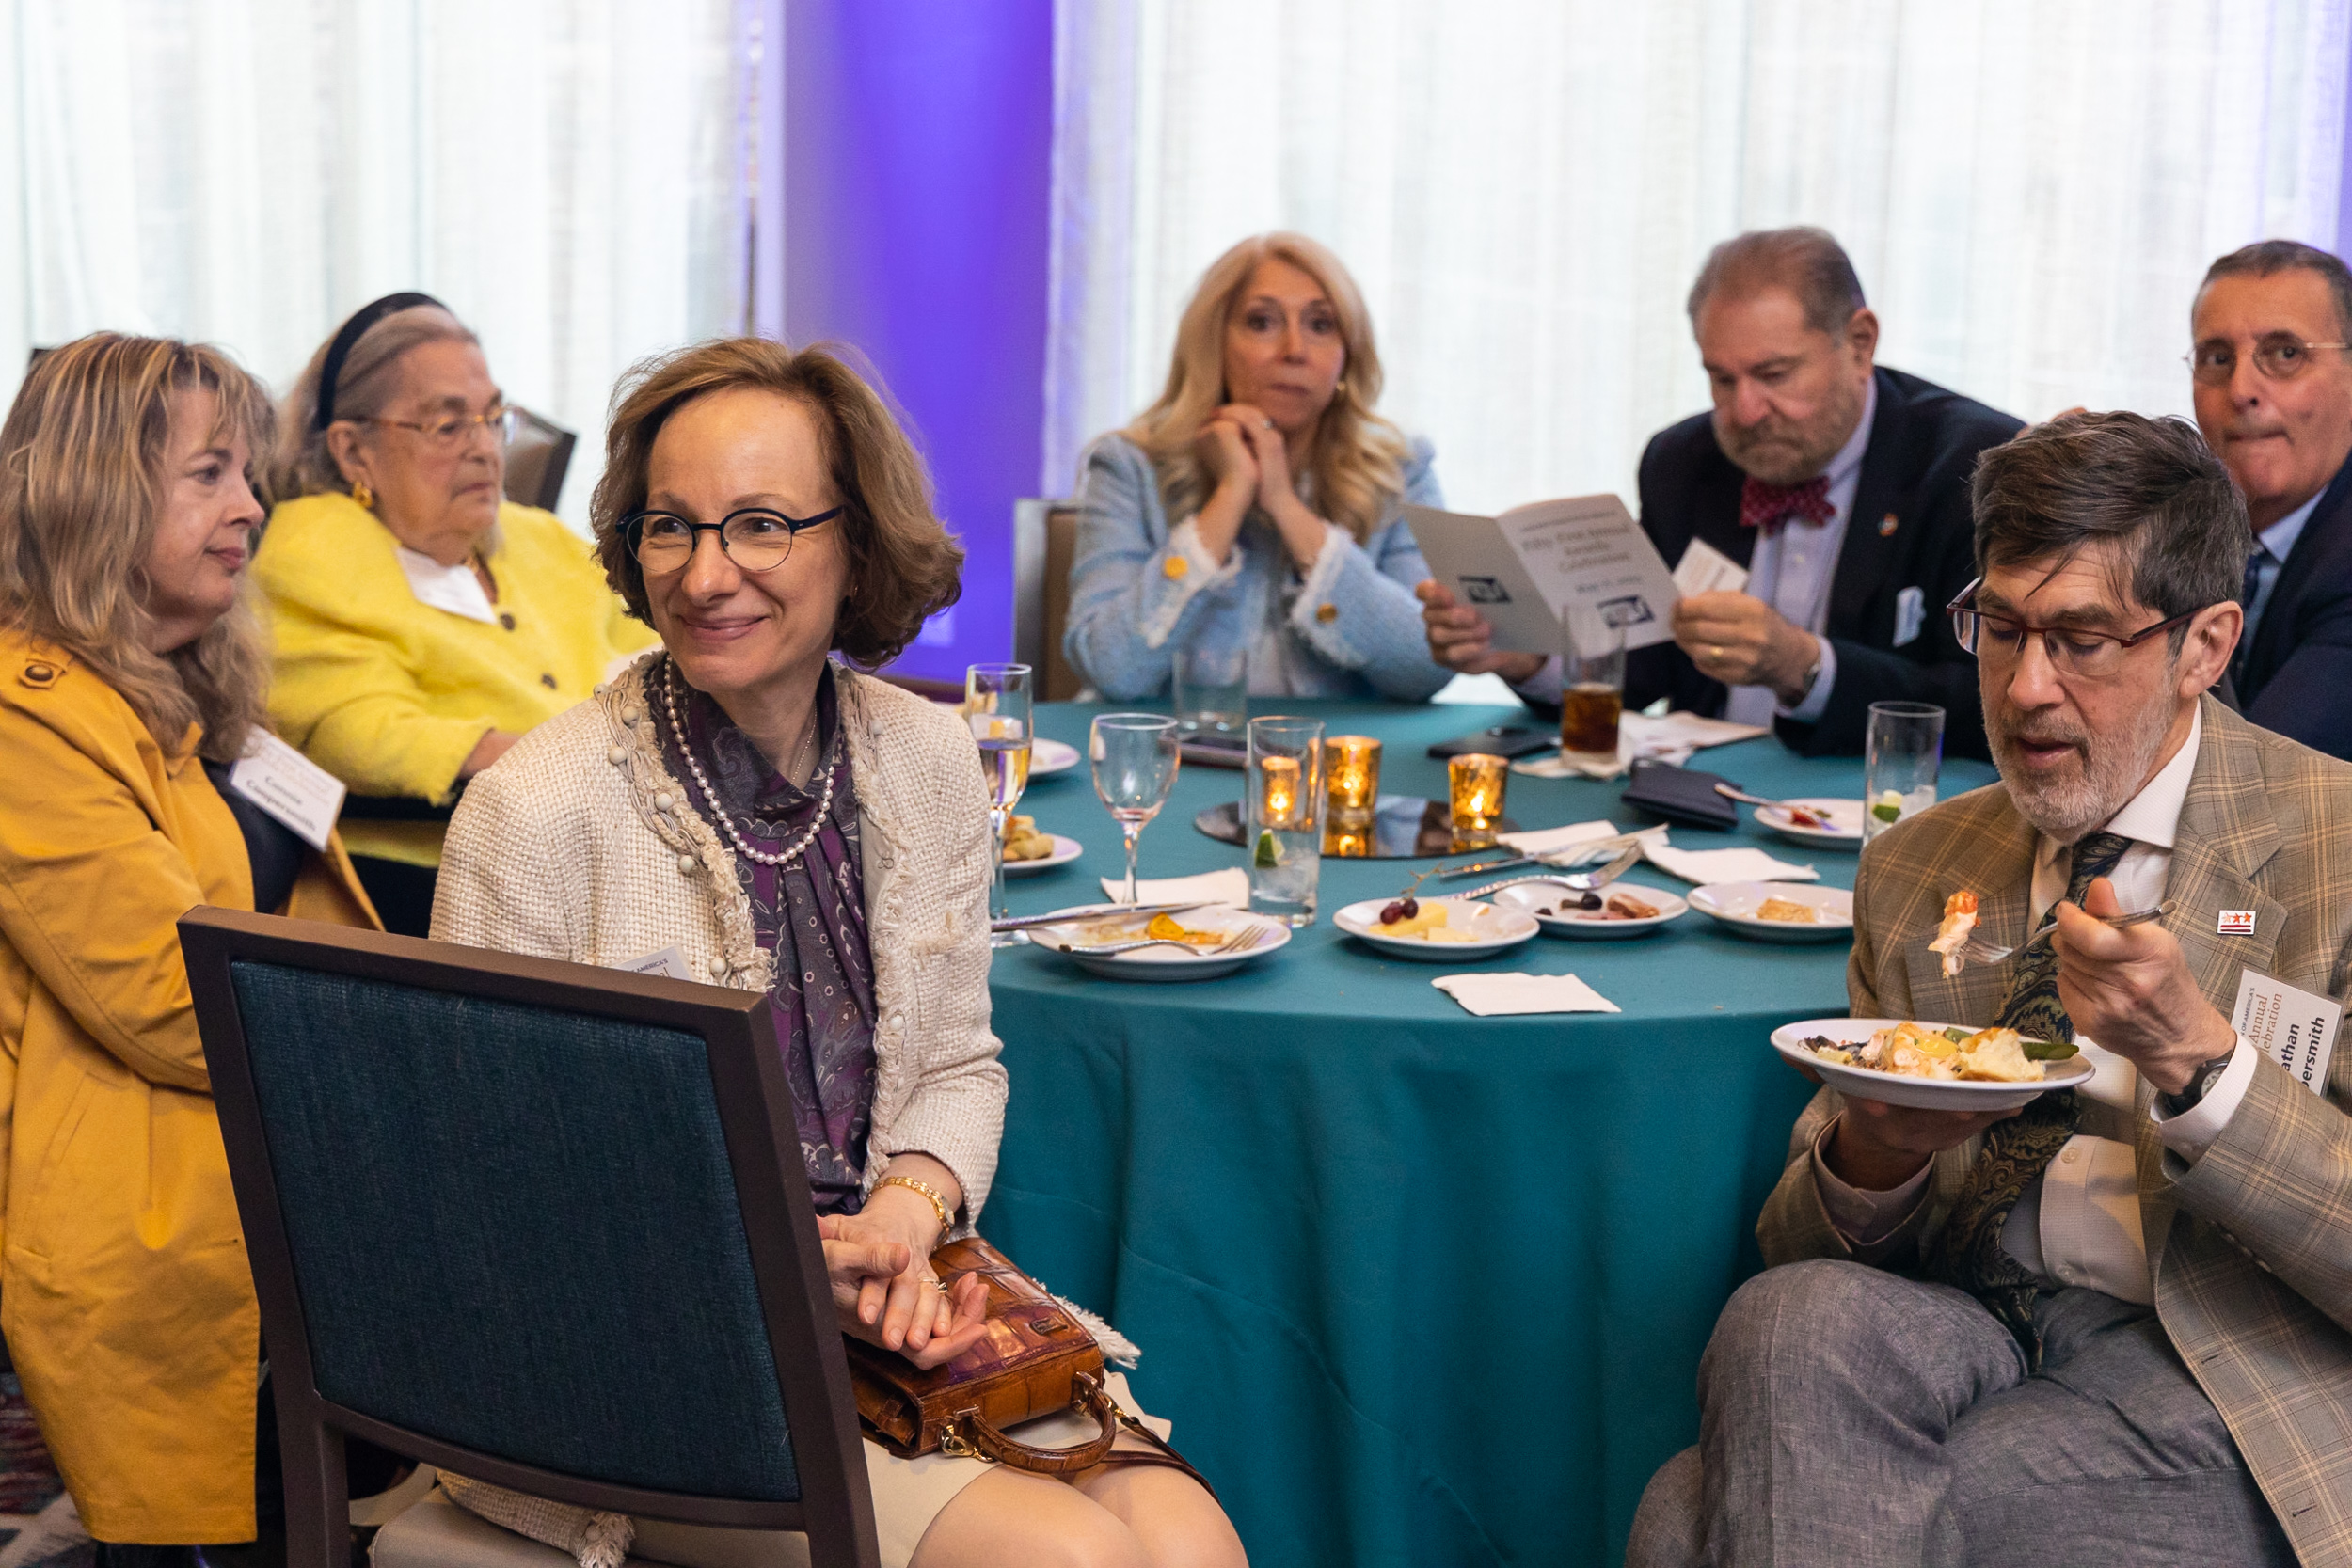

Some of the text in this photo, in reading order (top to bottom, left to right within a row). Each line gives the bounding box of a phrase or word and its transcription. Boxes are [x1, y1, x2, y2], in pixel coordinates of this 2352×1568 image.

[2249, 993, 2268, 1044] Annual
[2261, 993, 2283, 1053] lebration
[2280, 1023, 2300, 1072] athan
[2301, 1017, 2325, 1087] ersmith
